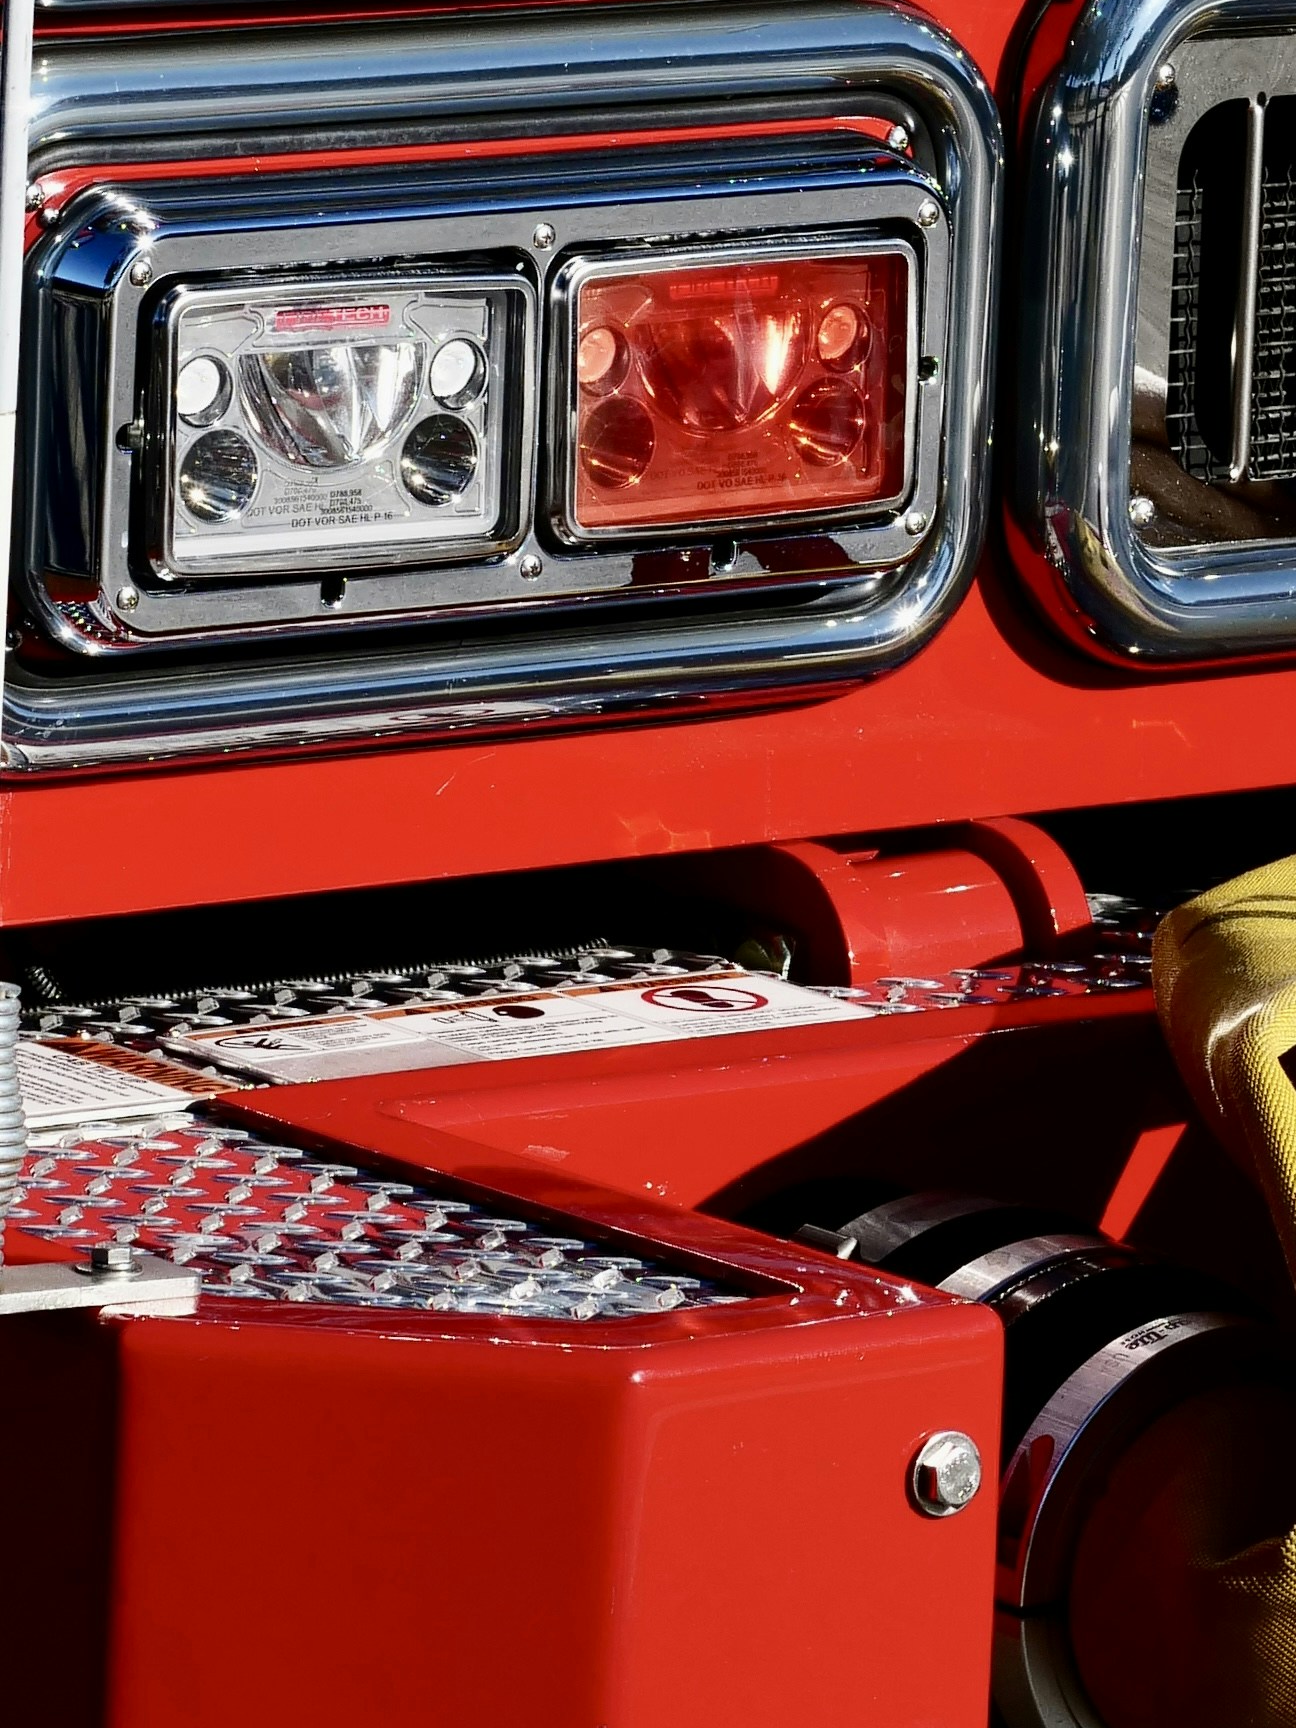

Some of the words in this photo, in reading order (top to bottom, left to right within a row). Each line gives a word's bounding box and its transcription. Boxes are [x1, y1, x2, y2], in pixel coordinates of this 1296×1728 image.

[291, 518, 312, 528] DOT
[314, 516, 336, 527] VOR
[338, 515, 358, 524] SAE
